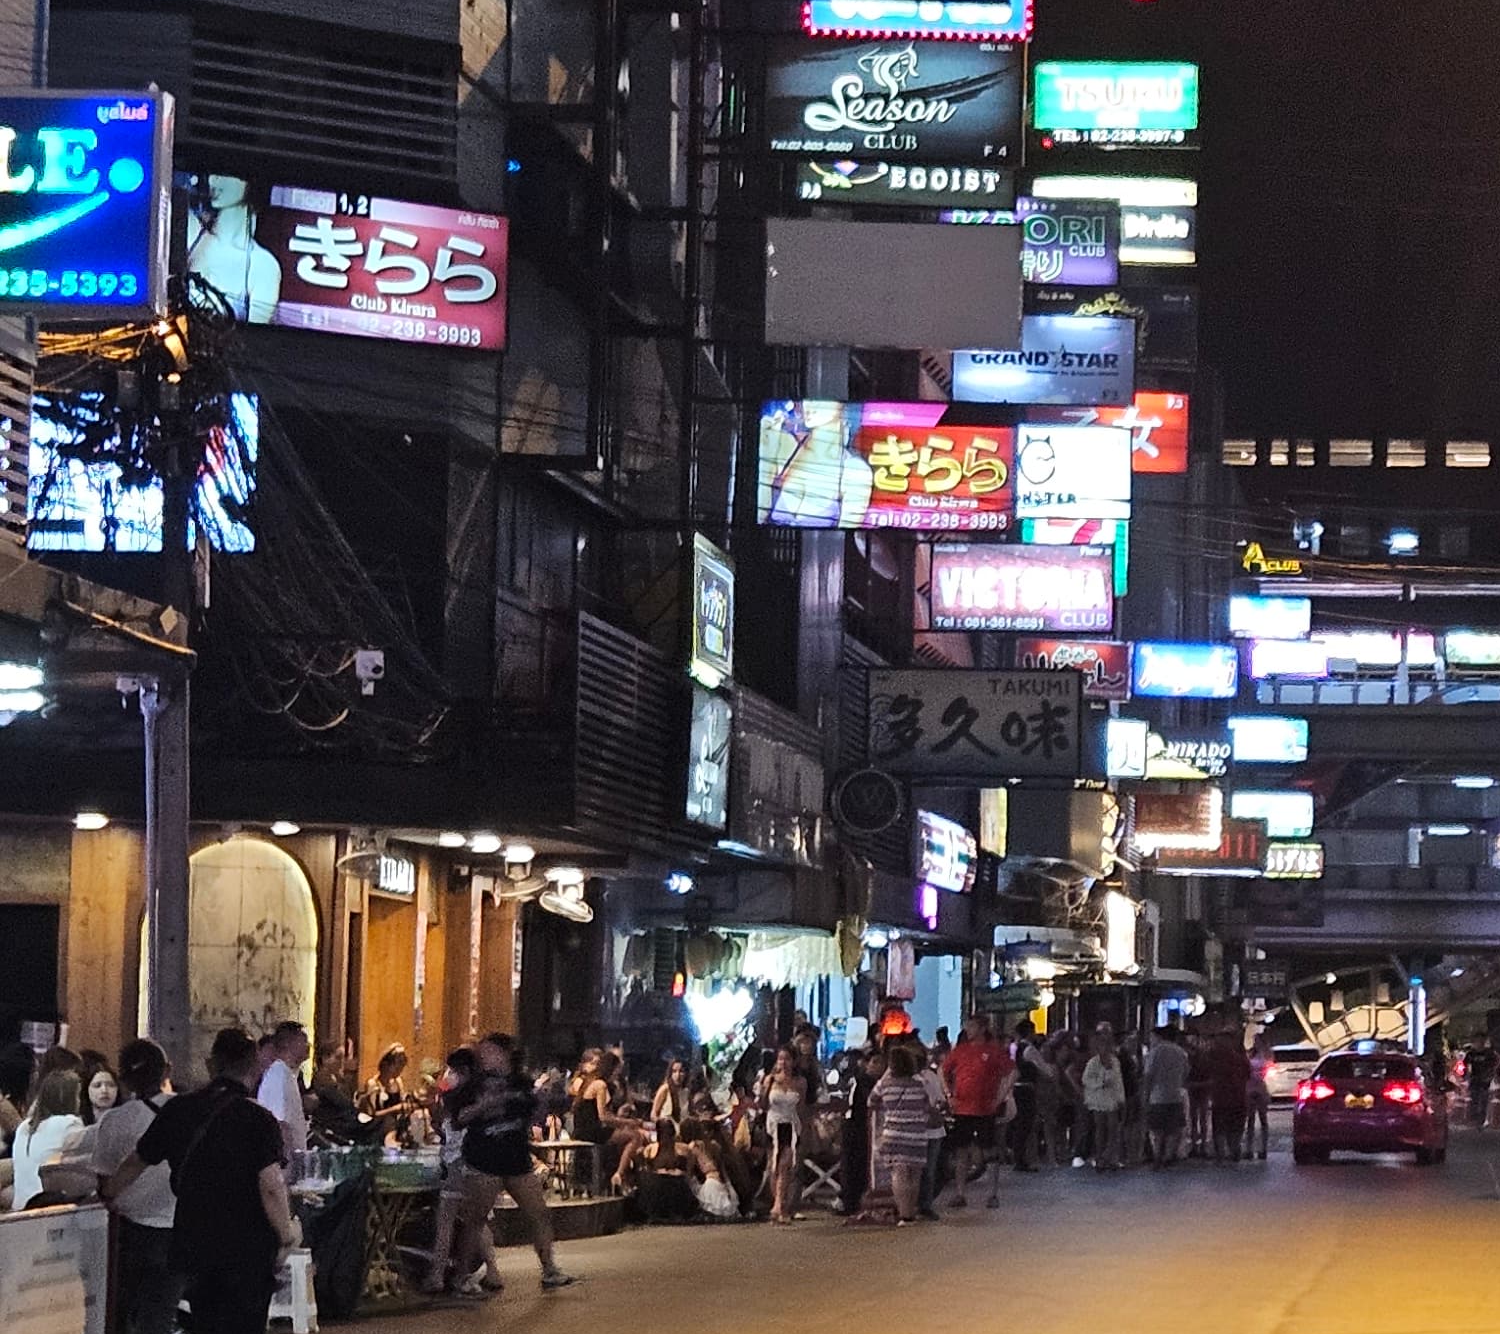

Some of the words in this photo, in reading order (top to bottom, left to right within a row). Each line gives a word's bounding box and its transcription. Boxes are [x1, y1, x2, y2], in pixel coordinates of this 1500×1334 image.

[863, 133, 918, 151] CLUB
[888, 165, 1001, 194] EGOIST
[288, 217, 498, 303] きらら
[1069, 245, 1106, 257] CLUB
[351, 294, 388, 314] Club
[390, 297, 437, 319] Kirara
[868, 434, 1008, 494] きらら
[908, 495, 938, 509] Club
[937, 565, 1108, 610] VICTORIA
[1059, 612, 1108, 628] CLUB
[987, 675, 1071, 698] TAKUMI
[1167, 740, 1232, 760] MIKADO
